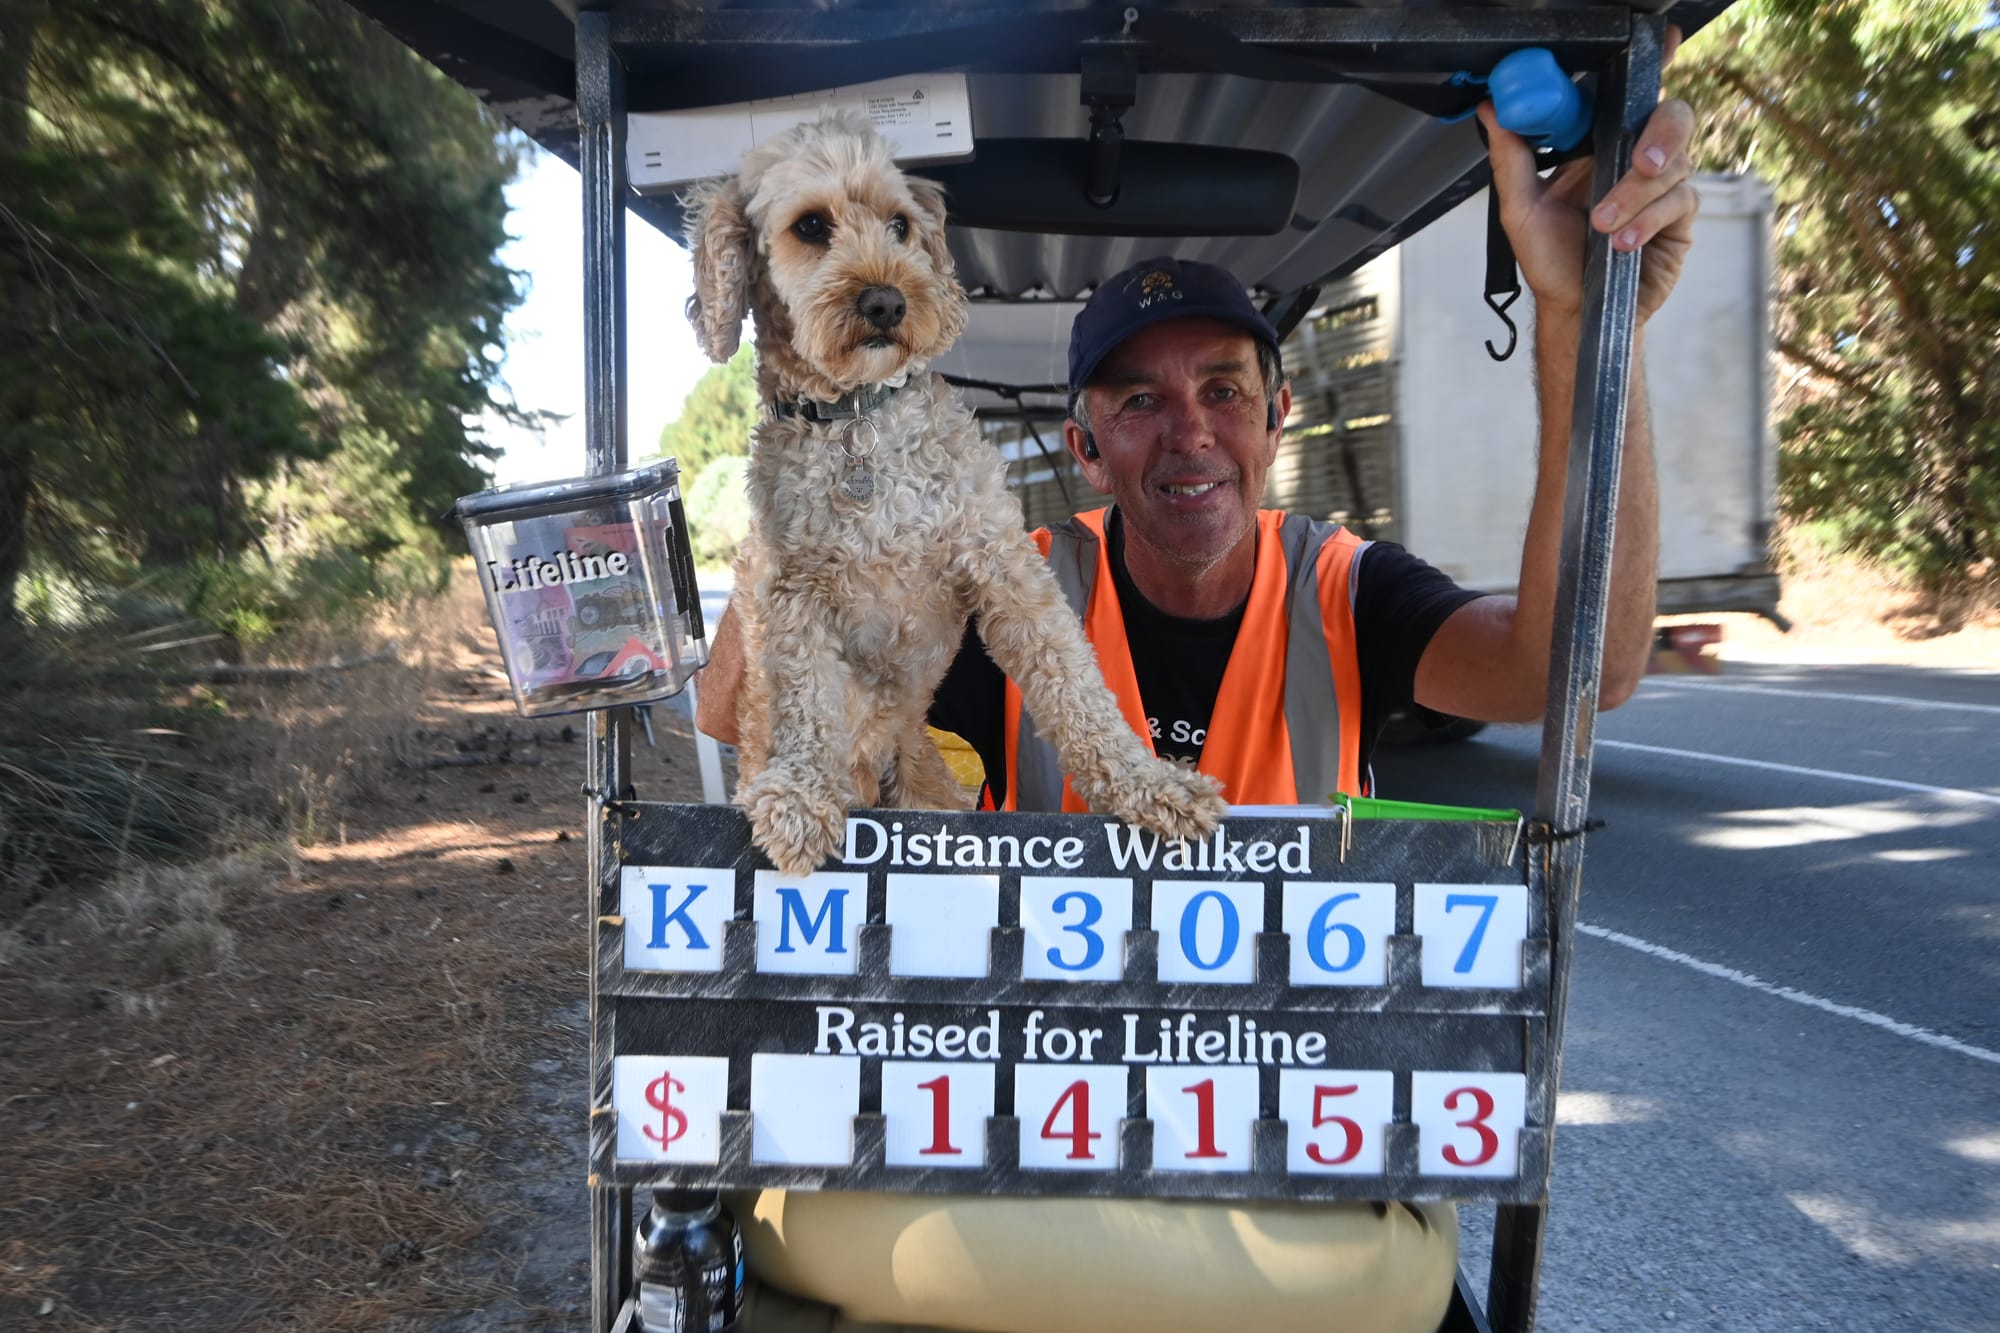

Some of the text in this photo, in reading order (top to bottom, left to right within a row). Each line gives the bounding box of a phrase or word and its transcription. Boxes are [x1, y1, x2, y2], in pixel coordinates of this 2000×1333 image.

[488, 550, 630, 593] Lifeline
[841, 817, 1312, 874] Distance Walked
[814, 1005, 1327, 1065] Raised for Lifeline
